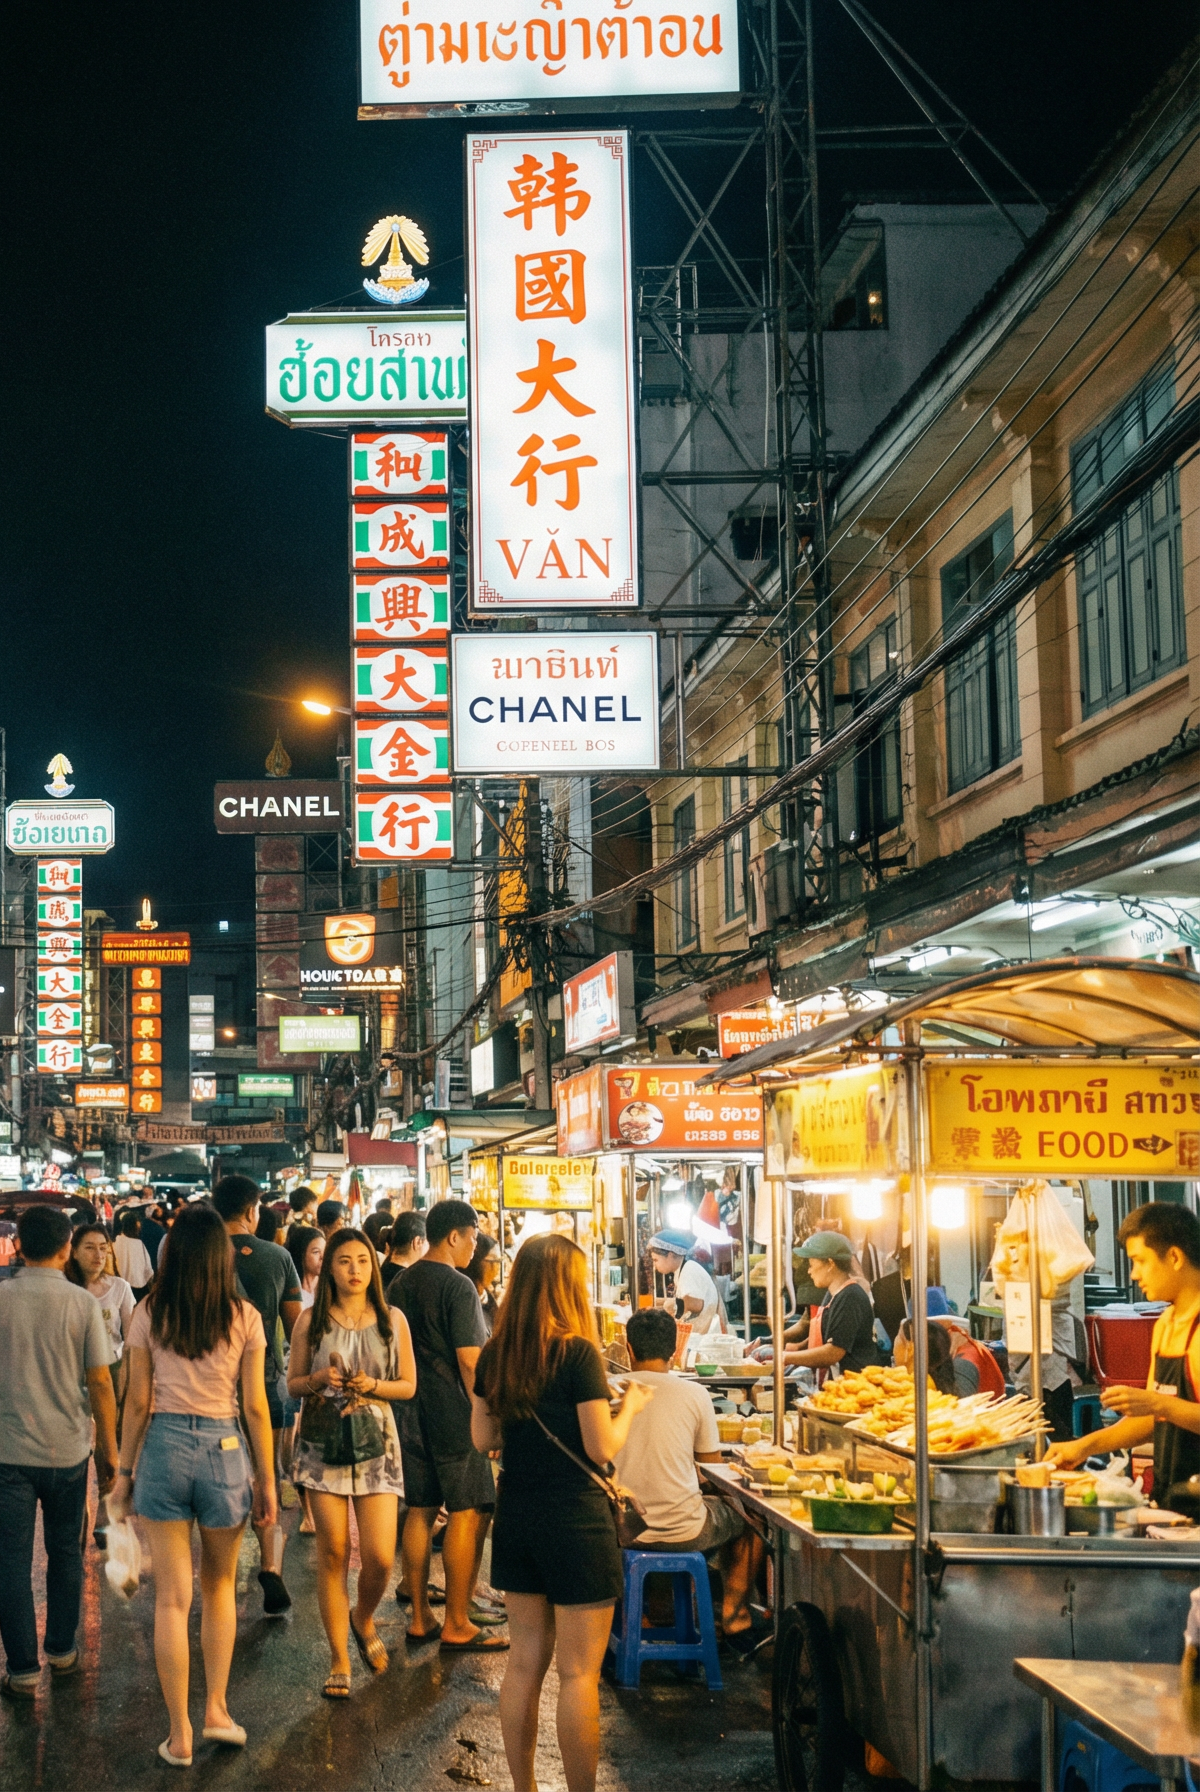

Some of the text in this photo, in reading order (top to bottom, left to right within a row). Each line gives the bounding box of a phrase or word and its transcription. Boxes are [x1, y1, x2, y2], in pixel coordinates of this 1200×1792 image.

[468, 695, 642, 724] CHANEL
[585, 739, 616, 752] BOS
[219, 796, 340, 818] CHANEL
